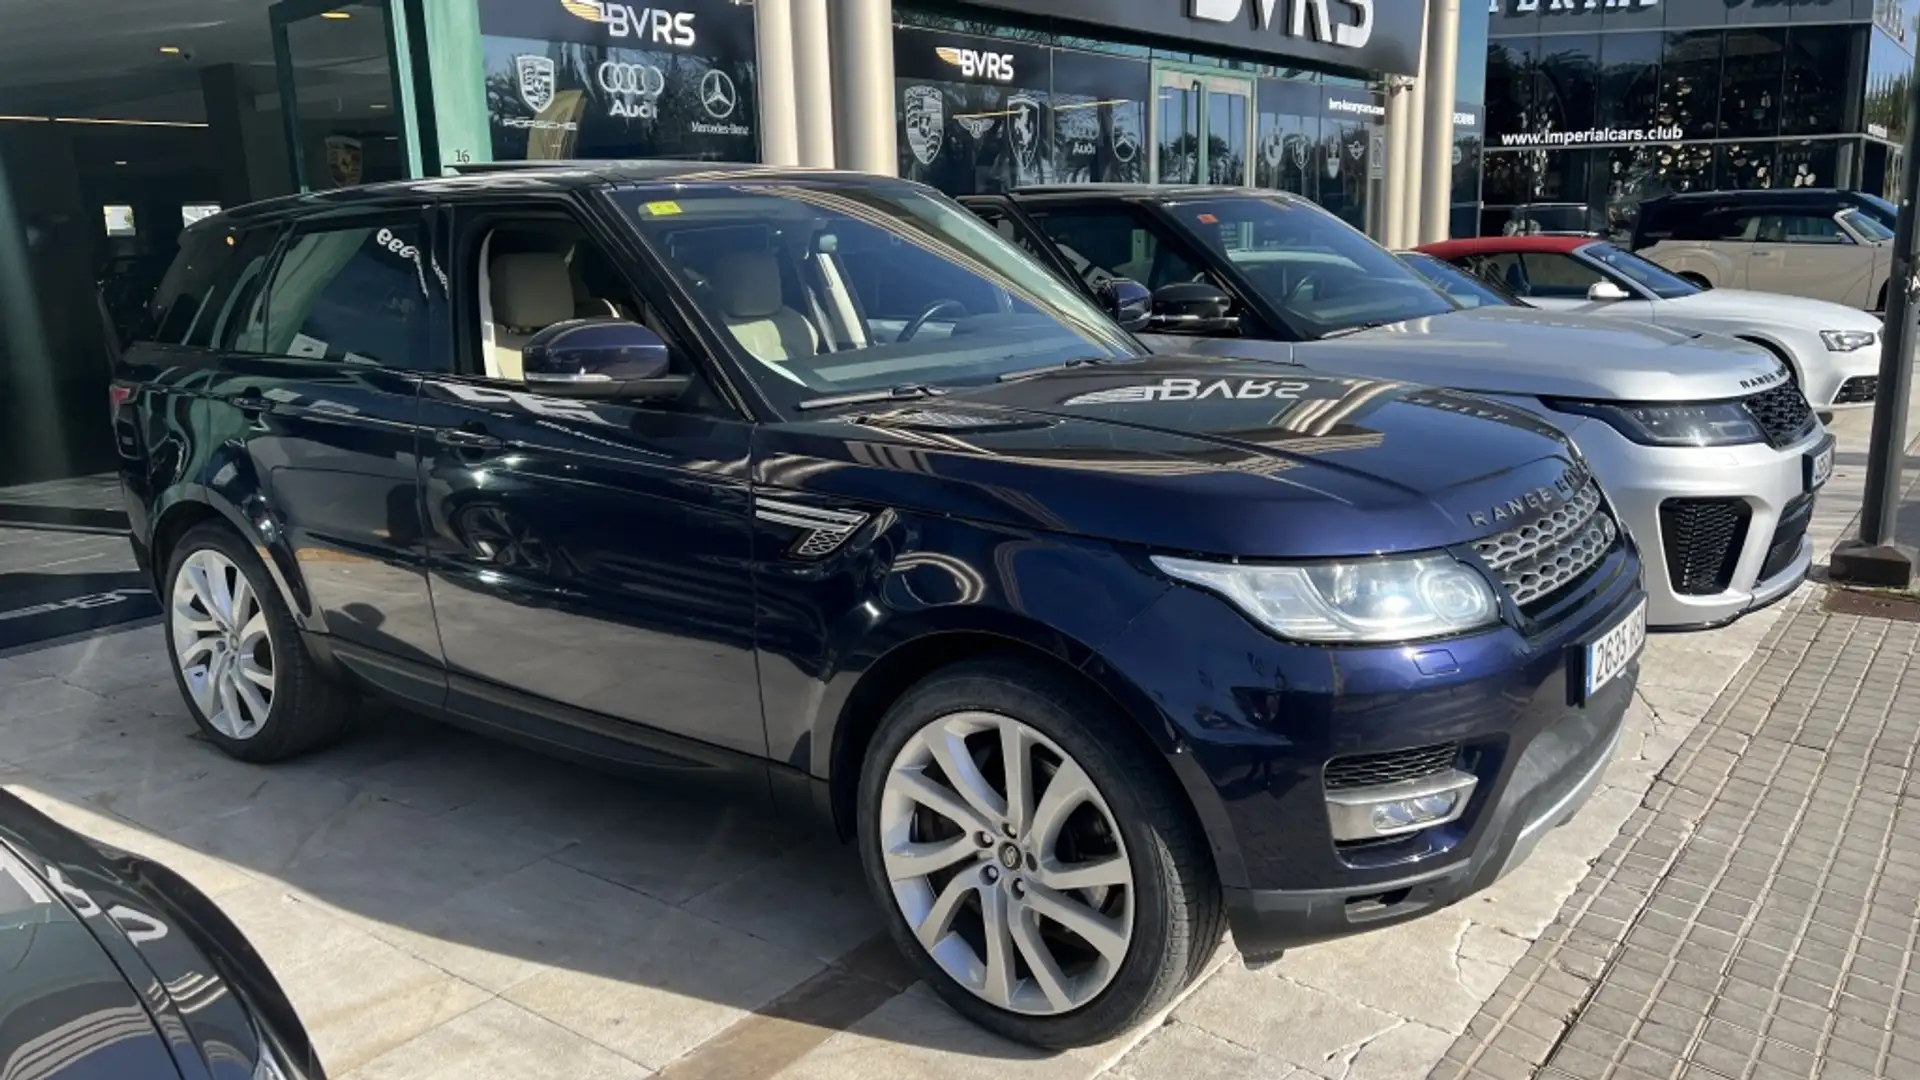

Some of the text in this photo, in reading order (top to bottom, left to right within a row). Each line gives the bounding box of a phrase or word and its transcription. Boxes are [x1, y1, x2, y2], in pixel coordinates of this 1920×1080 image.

[606, 3, 696, 47] BVRS
[960, 50, 1014, 80] BVRS
[610, 100, 658, 119] Audi
[1501, 124, 1684, 146] www.imperialcars.club
[454, 149, 470, 164] 16
[1467, 487, 1552, 528] RANGE
[1596, 624, 1627, 682] 2635
